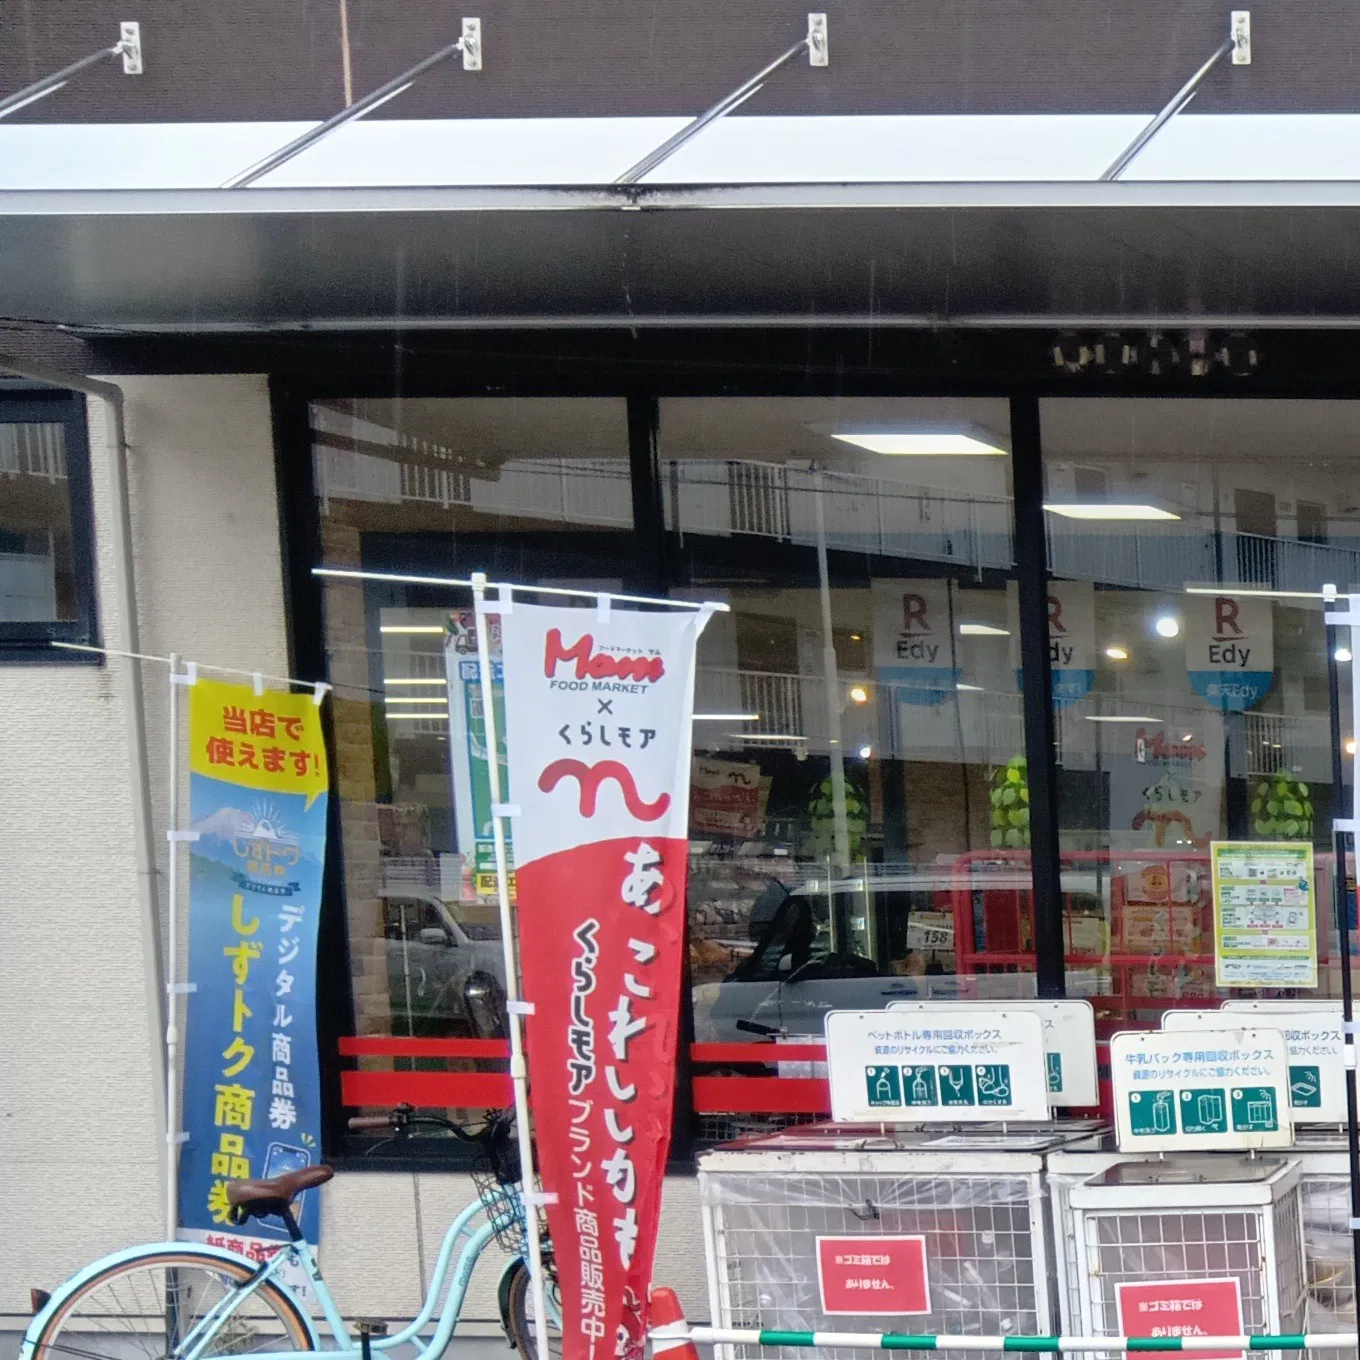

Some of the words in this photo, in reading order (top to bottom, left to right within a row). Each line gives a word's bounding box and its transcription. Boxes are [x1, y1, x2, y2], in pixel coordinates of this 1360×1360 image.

[897, 640, 939, 663] Edy
[1047, 641, 1073, 665] dy
[1209, 644, 1251, 668] Edy
[550, 680, 588, 691] FOOD
[592, 682, 649, 694] MARKET
[222, 705, 304, 741] 当店で
[558, 721, 656, 749] くらしモア
[206, 736, 321, 777] 使えます!
[269, 904, 305, 1131] デジタル商品券
